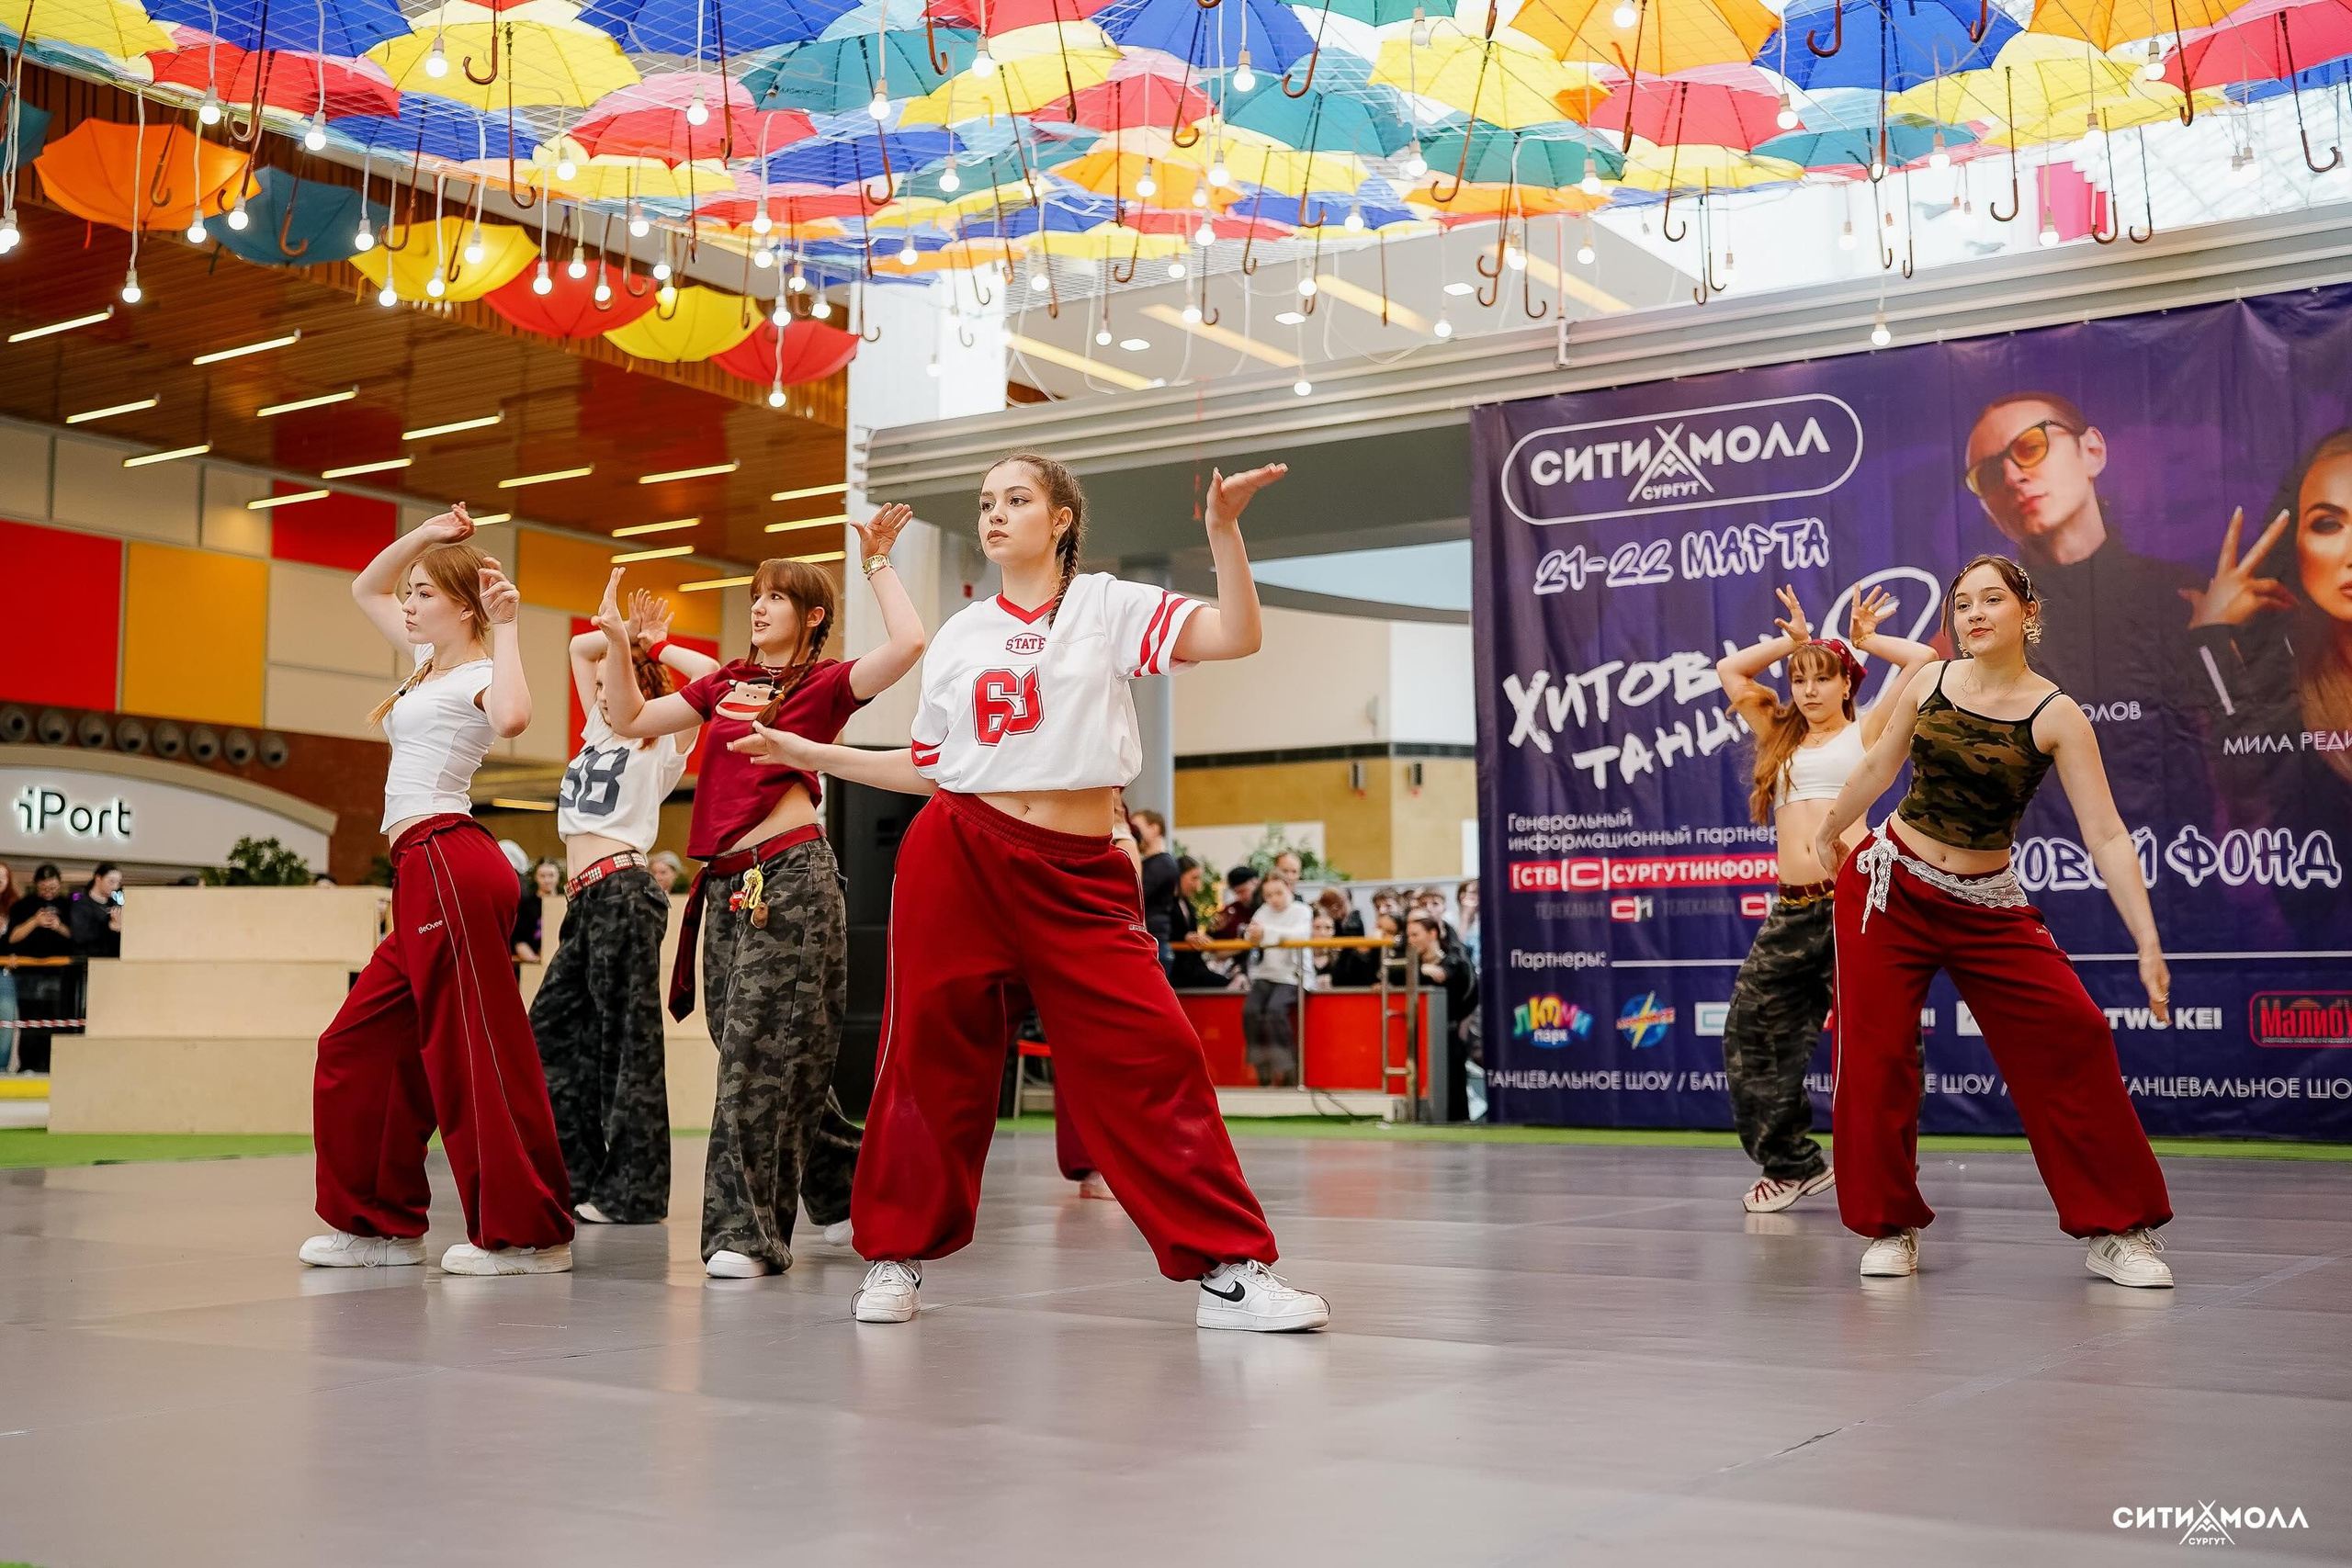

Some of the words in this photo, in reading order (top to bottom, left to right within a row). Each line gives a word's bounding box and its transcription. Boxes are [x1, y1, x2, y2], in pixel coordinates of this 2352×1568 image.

[1641, 479, 1700, 502] СУРГУТ
[1533, 537, 1674, 596] 21-22
[1680, 516, 1830, 581] МАРТА
[1005, 635, 1046, 652] STATE
[1502, 622, 1815, 753] ХИТОВ
[1572, 705, 1753, 790] ТАНЦ
[2223, 734, 2294, 756] МИЛА
[14, 784, 132, 840] iPort
[1509, 807, 1633, 832] Генеральный
[1508, 824, 1691, 854] информационный
[2165, 825, 2342, 889] ФОНД
[1510, 949, 1607, 971] Партнеры:
[2175, 1007, 2222, 1030] KEI
[1533, 1028, 1568, 1046] парк
[1487, 1069, 1621, 1092] ТАНЦЕВАЛЬНОЕ
[1625, 1070, 1673, 1091] ШОУ
[1941, 1073, 1996, 1095] ШОУ
